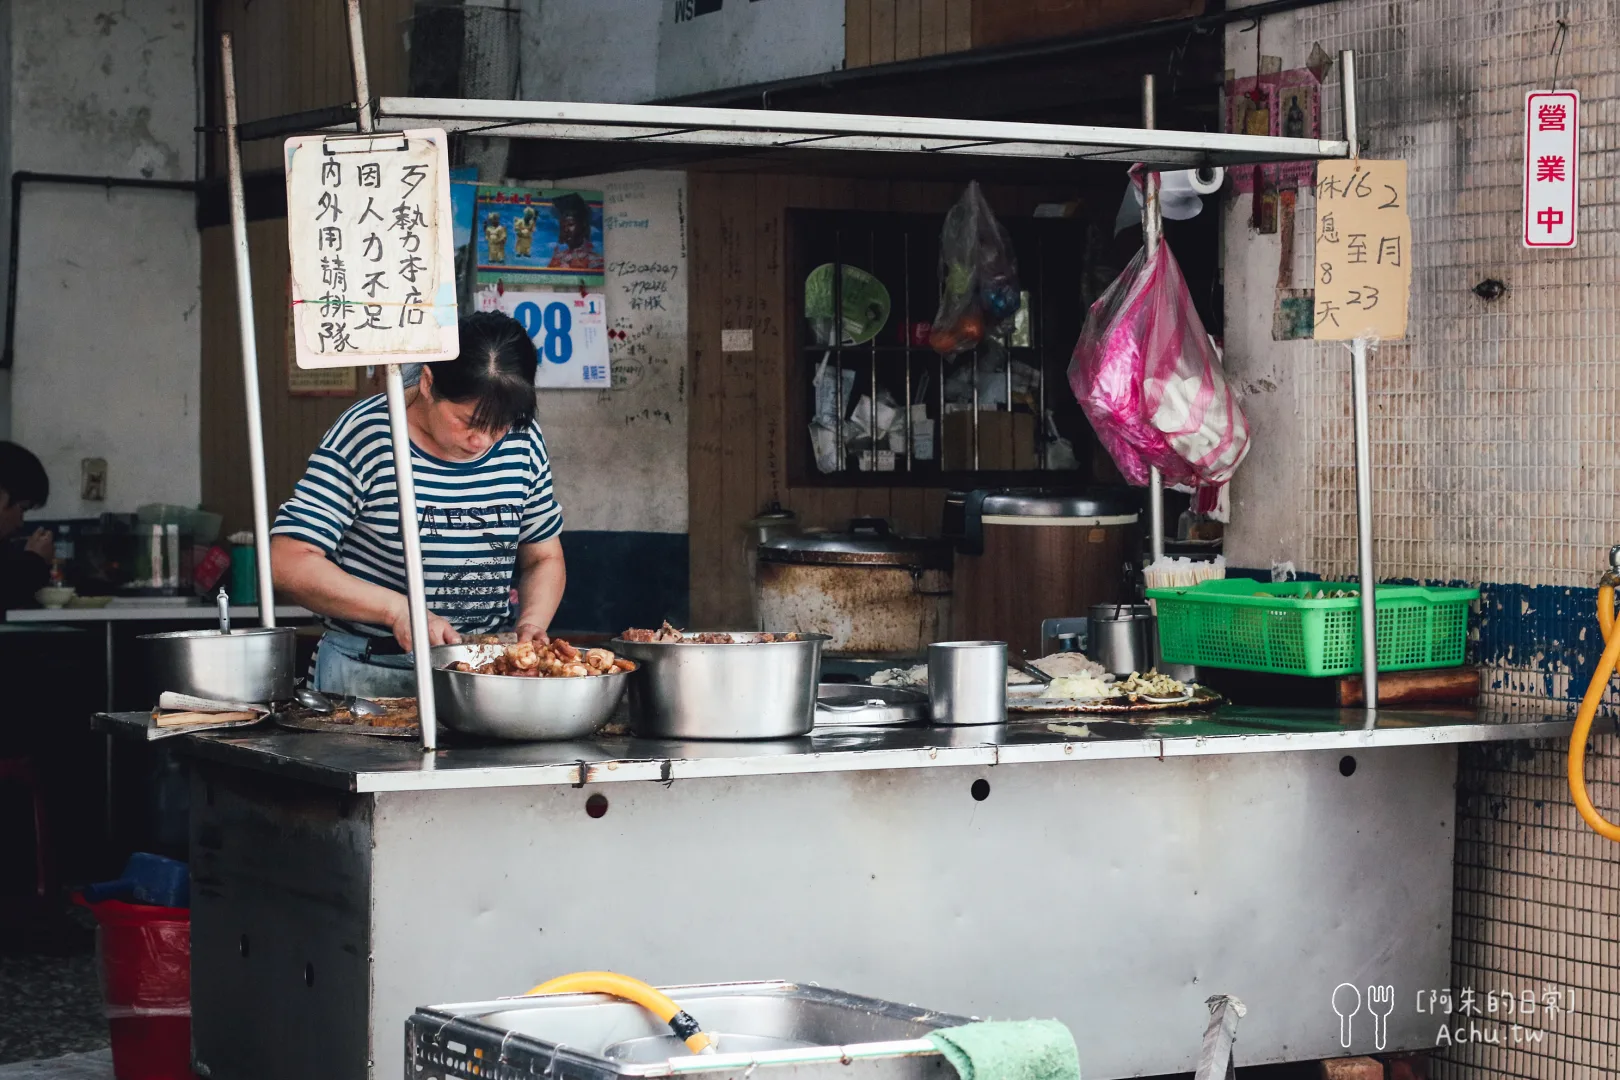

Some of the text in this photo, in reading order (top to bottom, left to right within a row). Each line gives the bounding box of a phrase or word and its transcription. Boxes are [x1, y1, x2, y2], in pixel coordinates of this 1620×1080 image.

[1537, 103, 1567, 234] 營業中
[353, 162, 393, 330] 因人力不足
[1314, 175, 1343, 328] 休息8天
[1377, 184, 1401, 268] 2月
[514, 301, 573, 366] 28
[589, 301, 597, 314] 1
